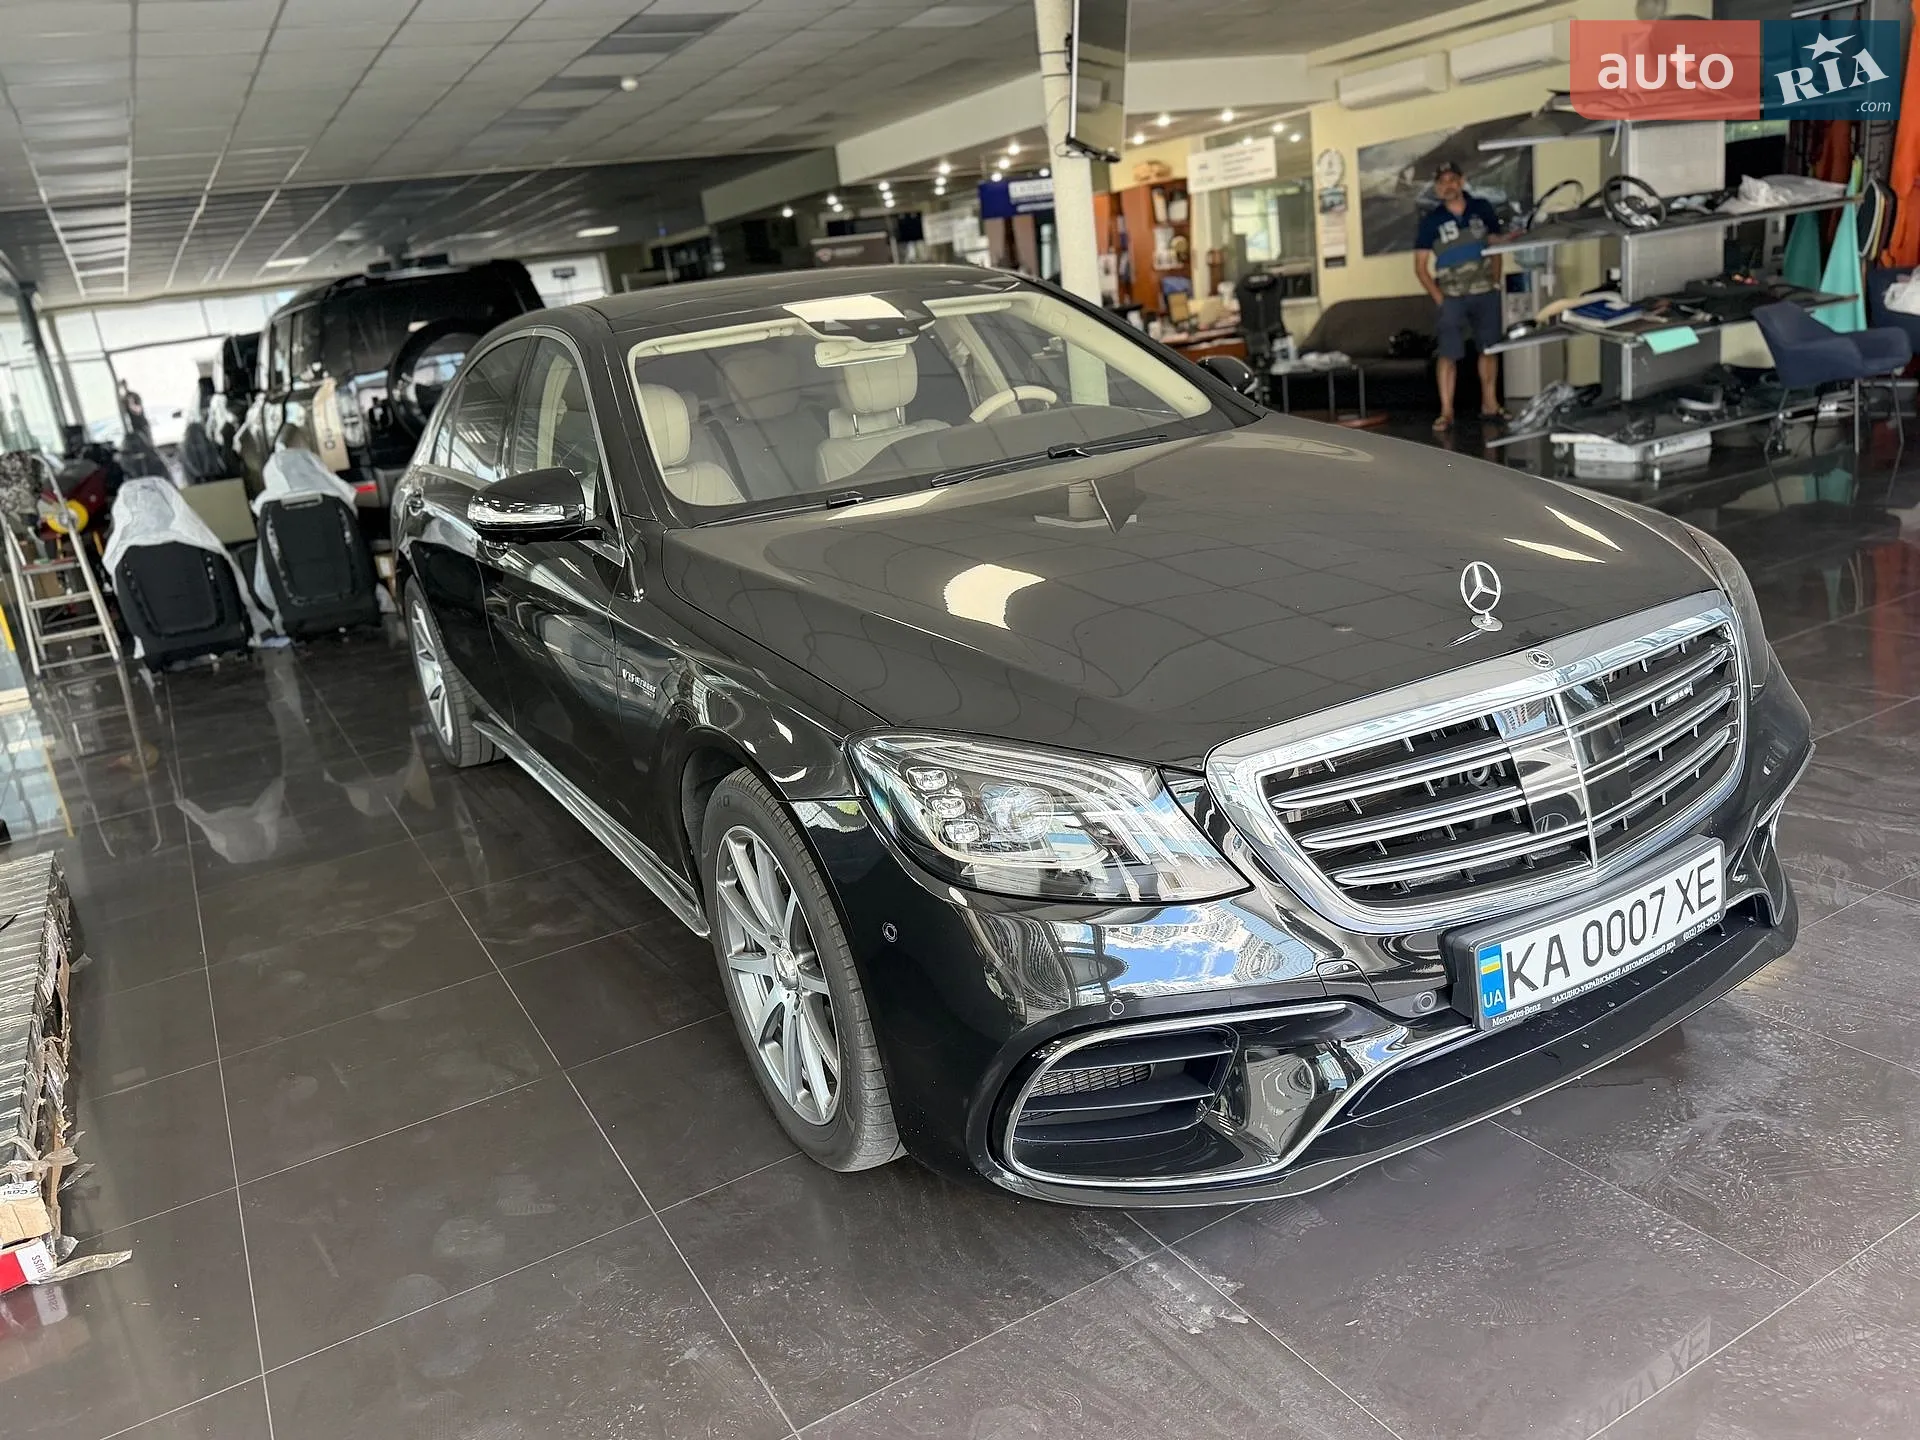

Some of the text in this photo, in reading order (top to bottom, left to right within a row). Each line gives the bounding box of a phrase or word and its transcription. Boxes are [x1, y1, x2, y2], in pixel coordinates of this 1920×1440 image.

[1438, 220, 1460, 243] 15
[1506, 858, 1717, 1000] KA 0007 XE
[1483, 990, 1504, 1009] UA
[1491, 1003, 1542, 1027] Mercedes-Benz
